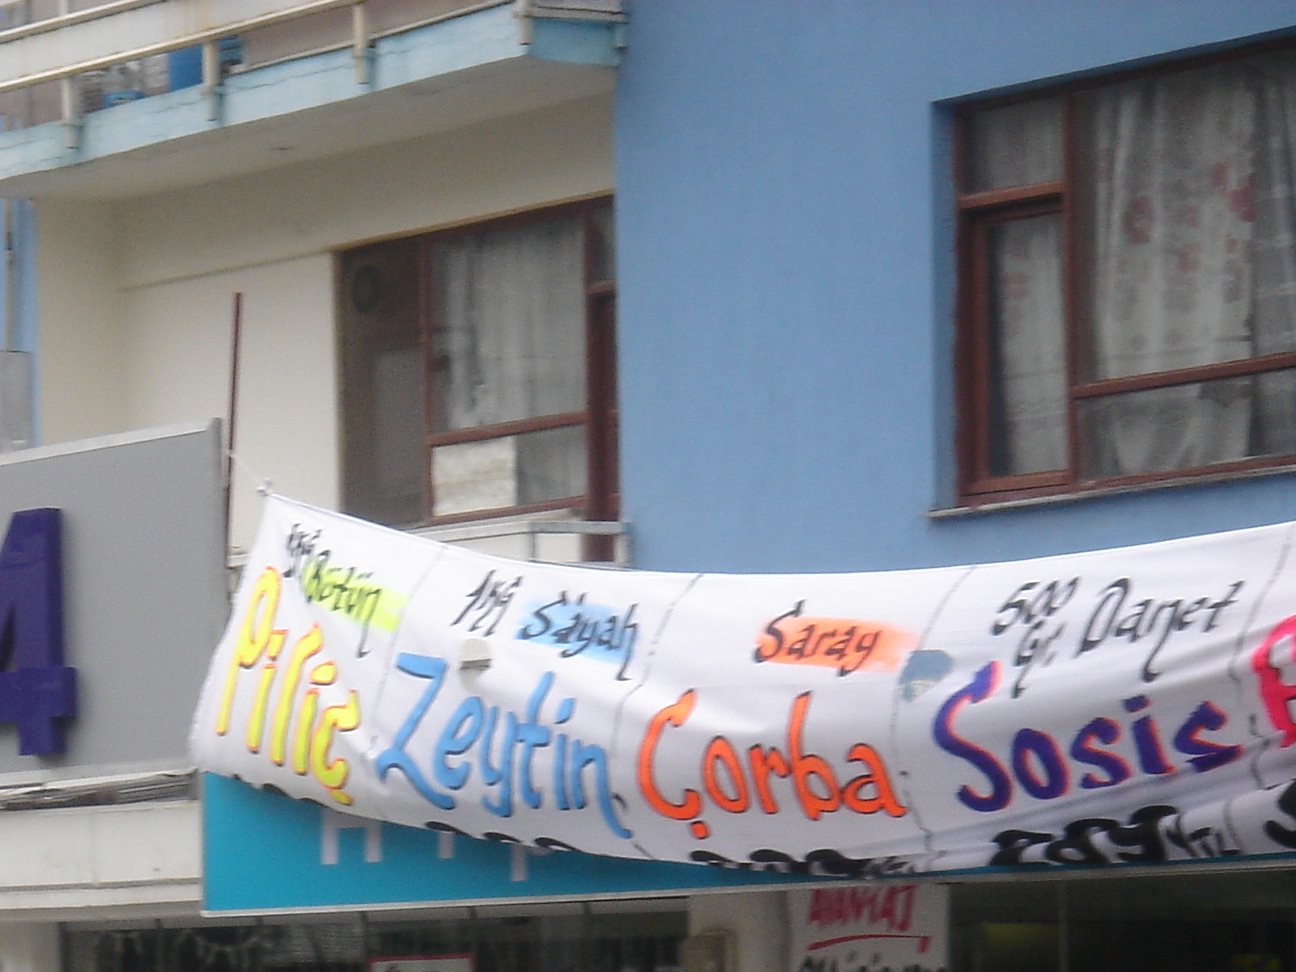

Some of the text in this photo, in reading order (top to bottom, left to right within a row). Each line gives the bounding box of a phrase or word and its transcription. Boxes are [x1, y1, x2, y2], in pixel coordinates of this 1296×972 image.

[752, 599, 882, 678] Saray
[376, 651, 632, 838] Zeytin
[637, 688, 908, 840] Çorba
[933, 659, 1245, 812] Sosis
